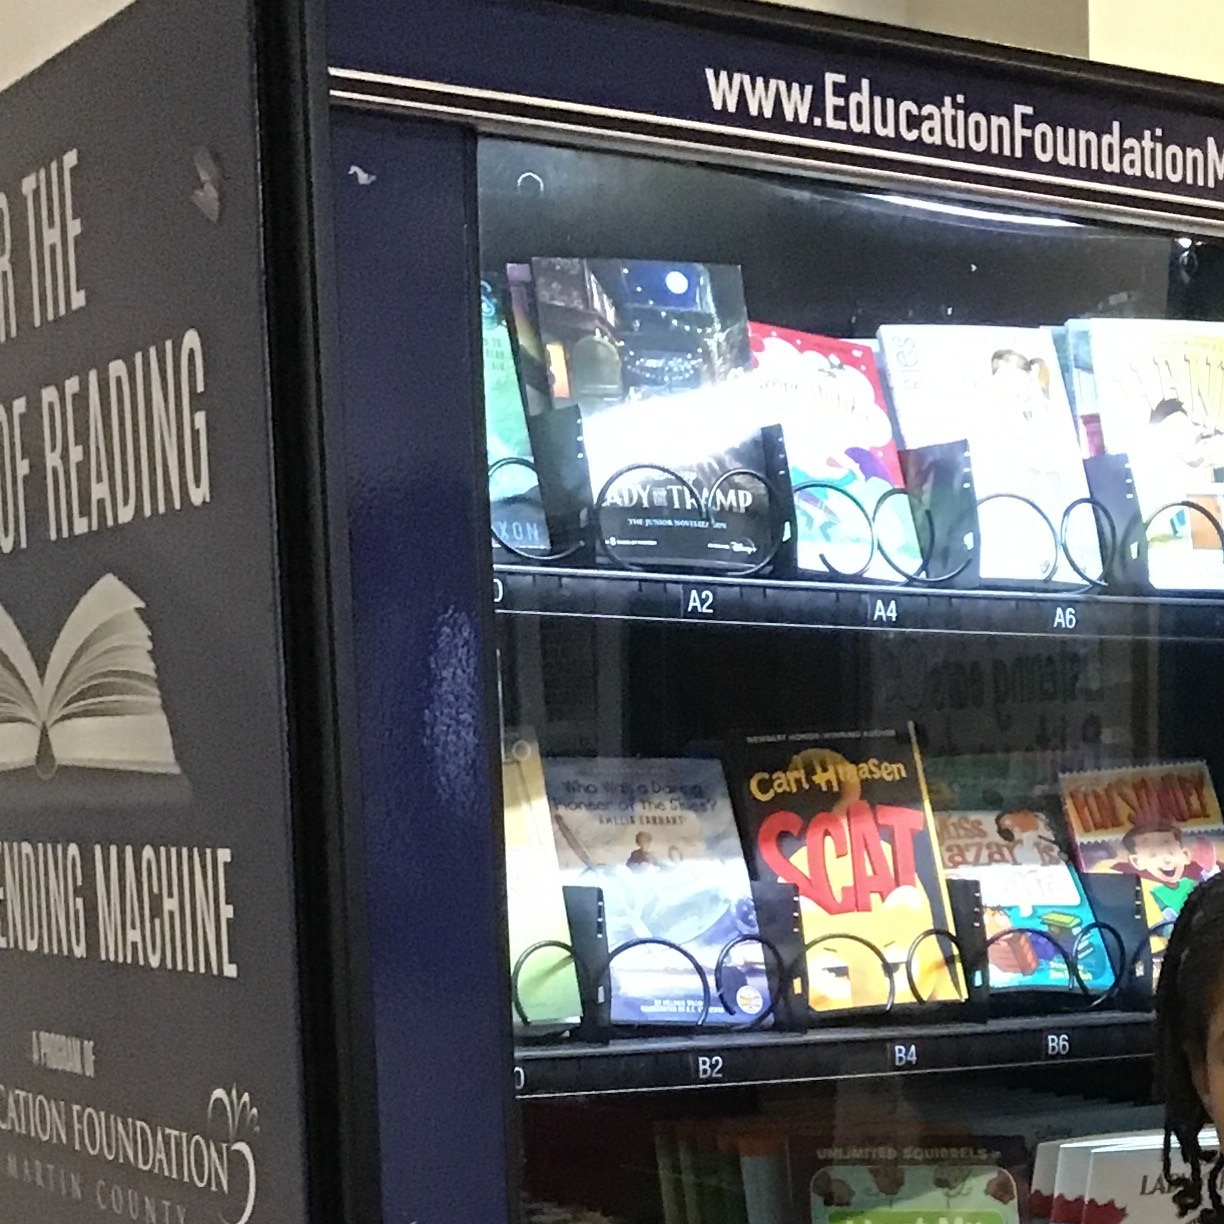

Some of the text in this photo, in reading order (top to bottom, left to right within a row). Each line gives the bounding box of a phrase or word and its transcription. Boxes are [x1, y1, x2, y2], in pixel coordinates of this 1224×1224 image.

[21, 148, 86, 329] THE
[41, 328, 210, 542] READING
[600, 484, 652, 510] ADY
[674, 519, 728, 530] NOVELIZION
[687, 589, 714, 615] A2
[873, 599, 897, 623] A4
[1053, 606, 1077, 629] A6
[758, 800, 925, 915] SCAT
[94, 844, 238, 978] MACHINE
[894, 1043, 918, 1066] B4
[1047, 1034, 1070, 1056] B6
[698, 1056, 724, 1079] B2
[73, 1104, 229, 1194] FOUNDATION
